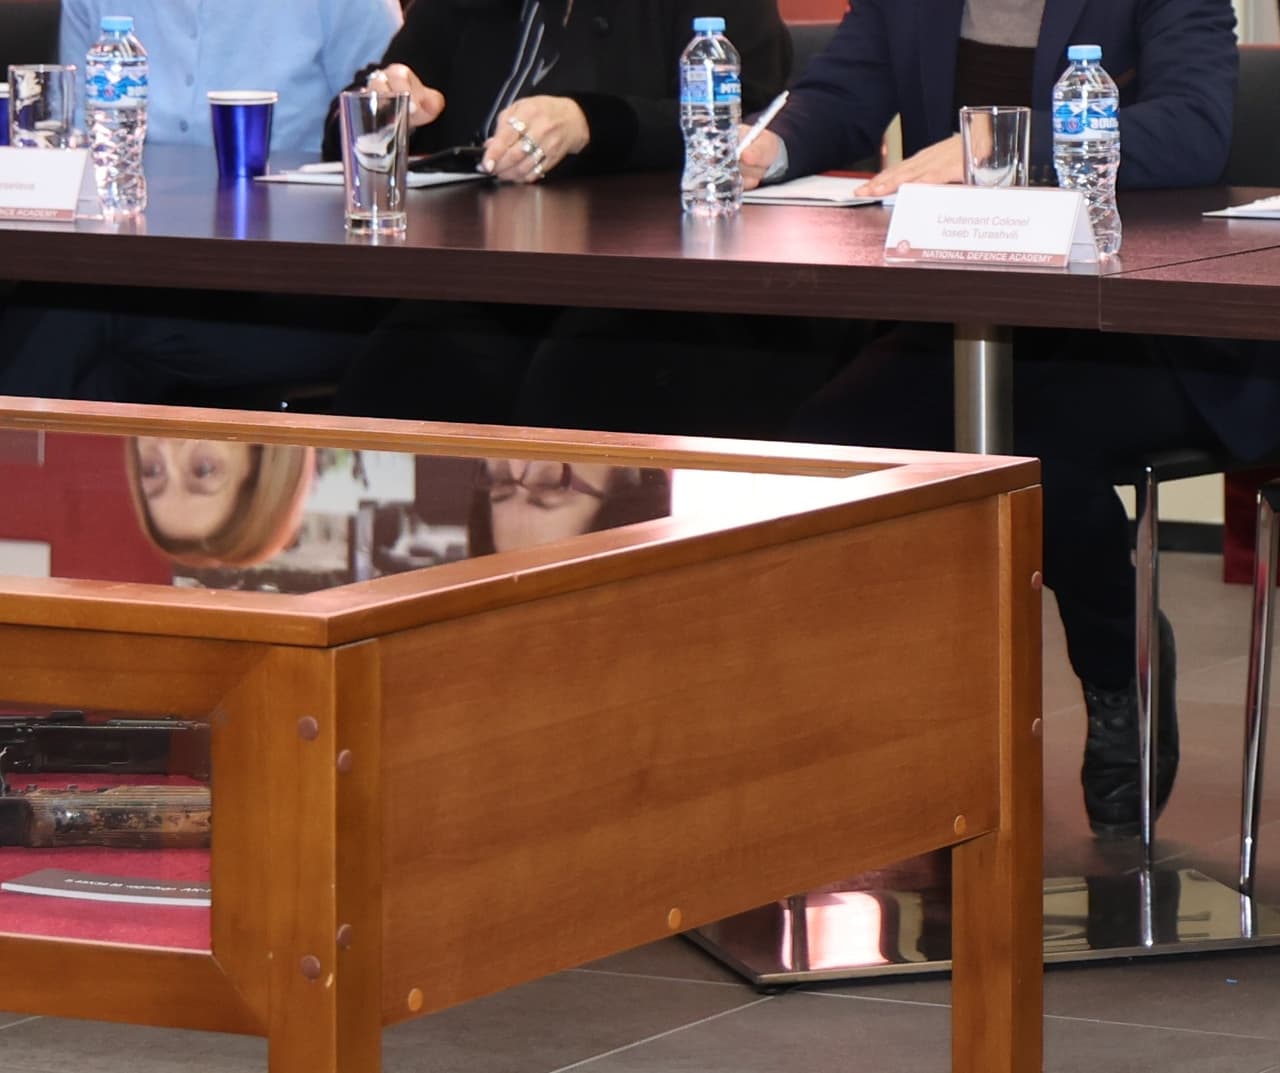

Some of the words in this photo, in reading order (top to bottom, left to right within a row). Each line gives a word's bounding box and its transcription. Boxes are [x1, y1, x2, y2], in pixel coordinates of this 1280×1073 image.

[937, 213, 990, 226] Lieutenant
[992, 215, 1030, 227] Colonel
[921, 250, 965, 261] NATIONAL
[966, 251, 1007, 262] DEFENCE
[1008, 253, 1053, 263] ACADEMY
